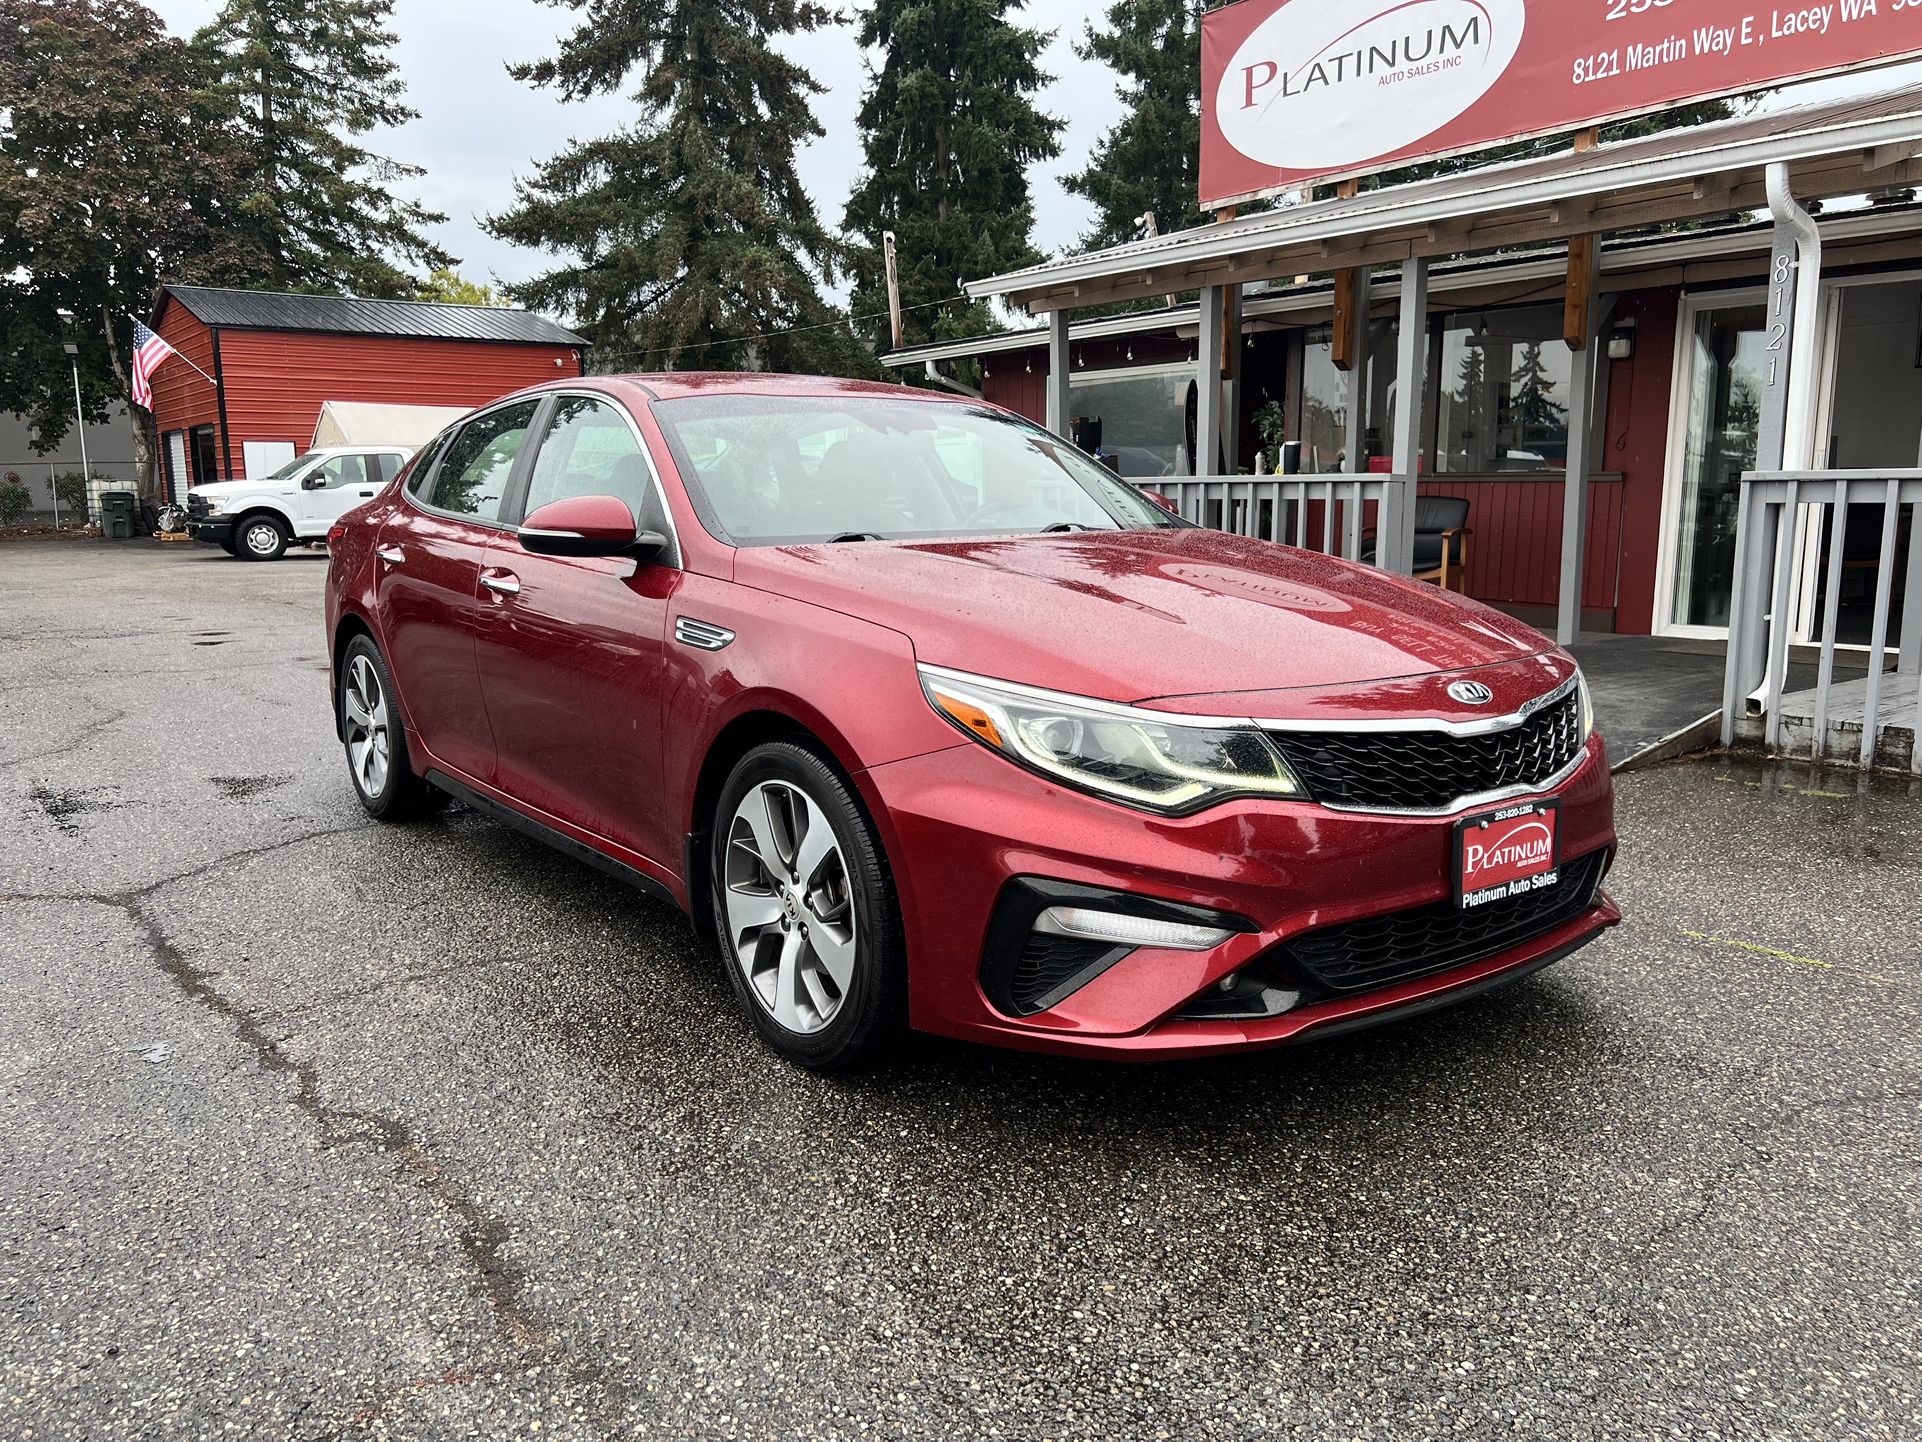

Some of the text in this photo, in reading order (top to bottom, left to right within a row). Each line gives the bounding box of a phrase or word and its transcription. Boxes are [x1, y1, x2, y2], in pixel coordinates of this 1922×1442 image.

[1572, 48, 1621, 85] 8121
[1625, 37, 1687, 73] Martin
[1693, 25, 1735, 56] Way
[1740, 16, 1754, 45] E
[1771, 3, 1833, 38] Lacey
[1840, 0, 1877, 22] WA
[1240, 16, 1480, 110] PLATINUM
[1378, 55, 1462, 87] AUTO SALES INC
[1766, 254, 1790, 386] 8121
[1465, 836, 1551, 874] PLATINUM
[785, 892, 796, 917] KIA
[1462, 872, 1557, 908] Platinum Auto Sales
